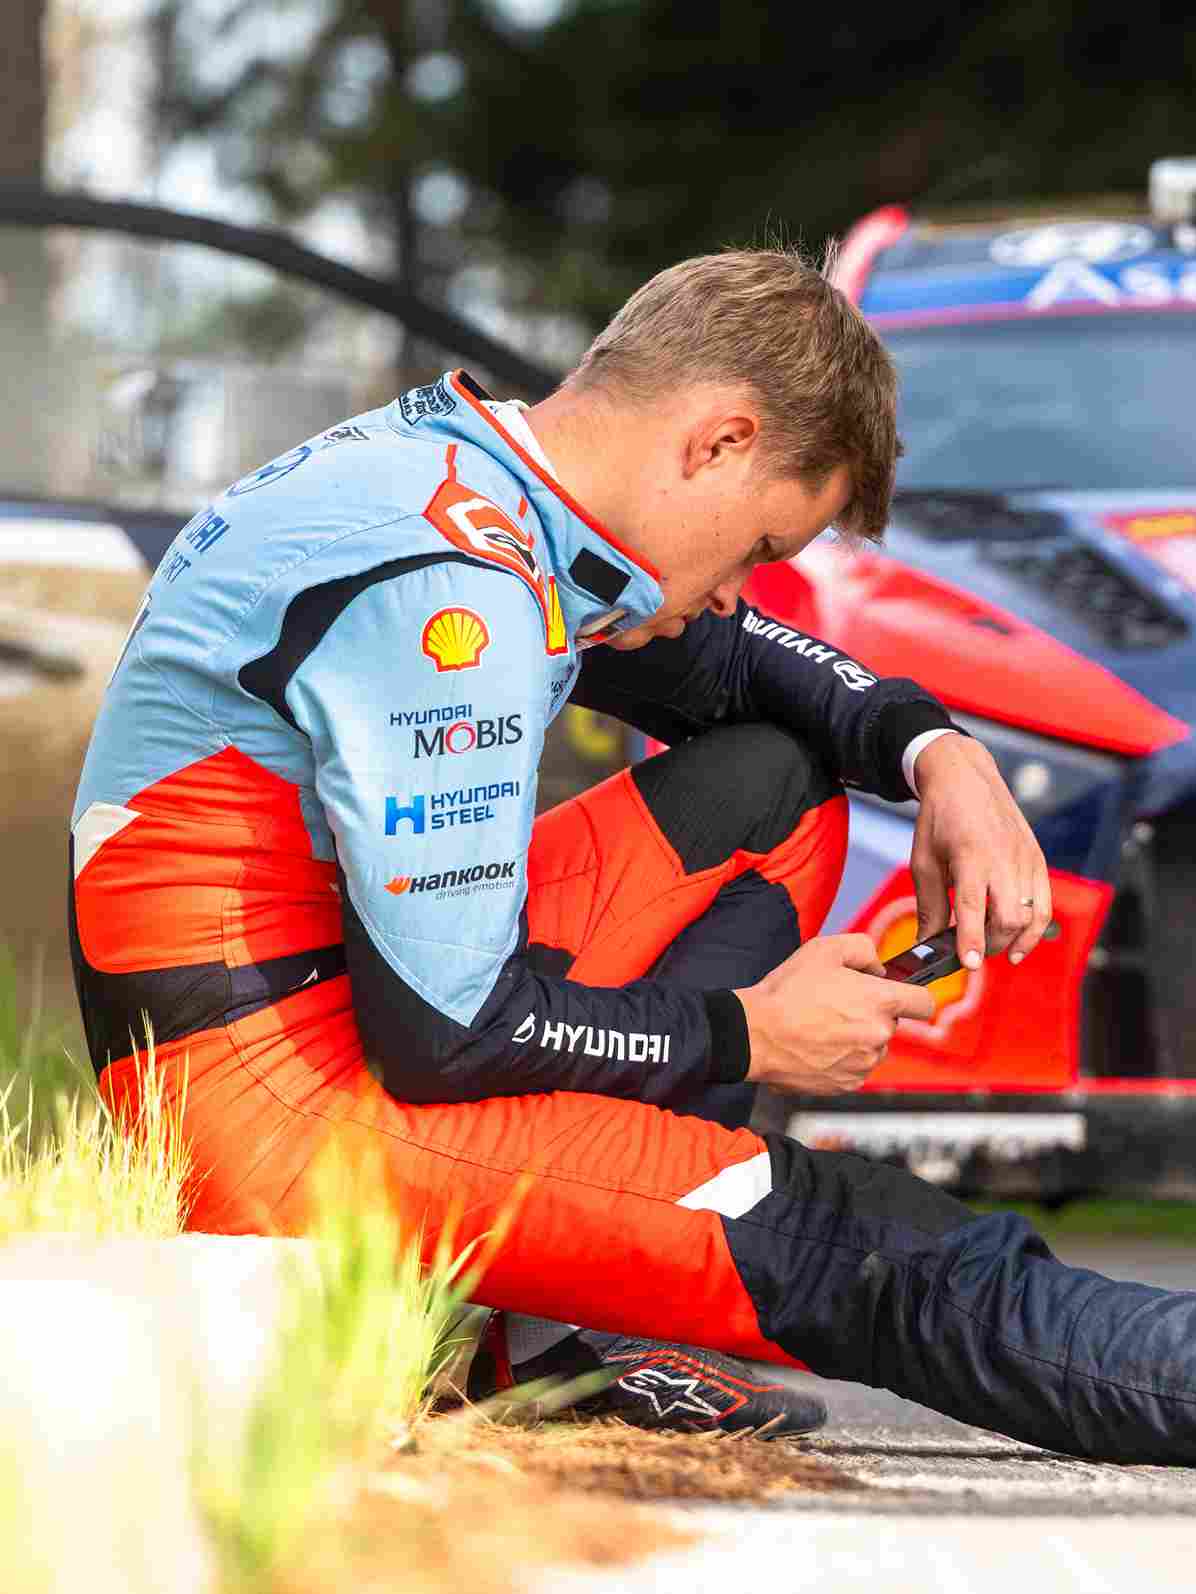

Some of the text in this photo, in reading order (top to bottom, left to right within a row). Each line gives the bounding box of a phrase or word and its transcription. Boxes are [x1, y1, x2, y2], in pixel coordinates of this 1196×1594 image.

[389, 703, 473, 727] HYUNDAI
[413, 714, 523, 759] MOBIS
[431, 780, 520, 810] HYUNDAI
[431, 805, 495, 831] STEEL
[540, 1019, 671, 1064] HYUNDAI
